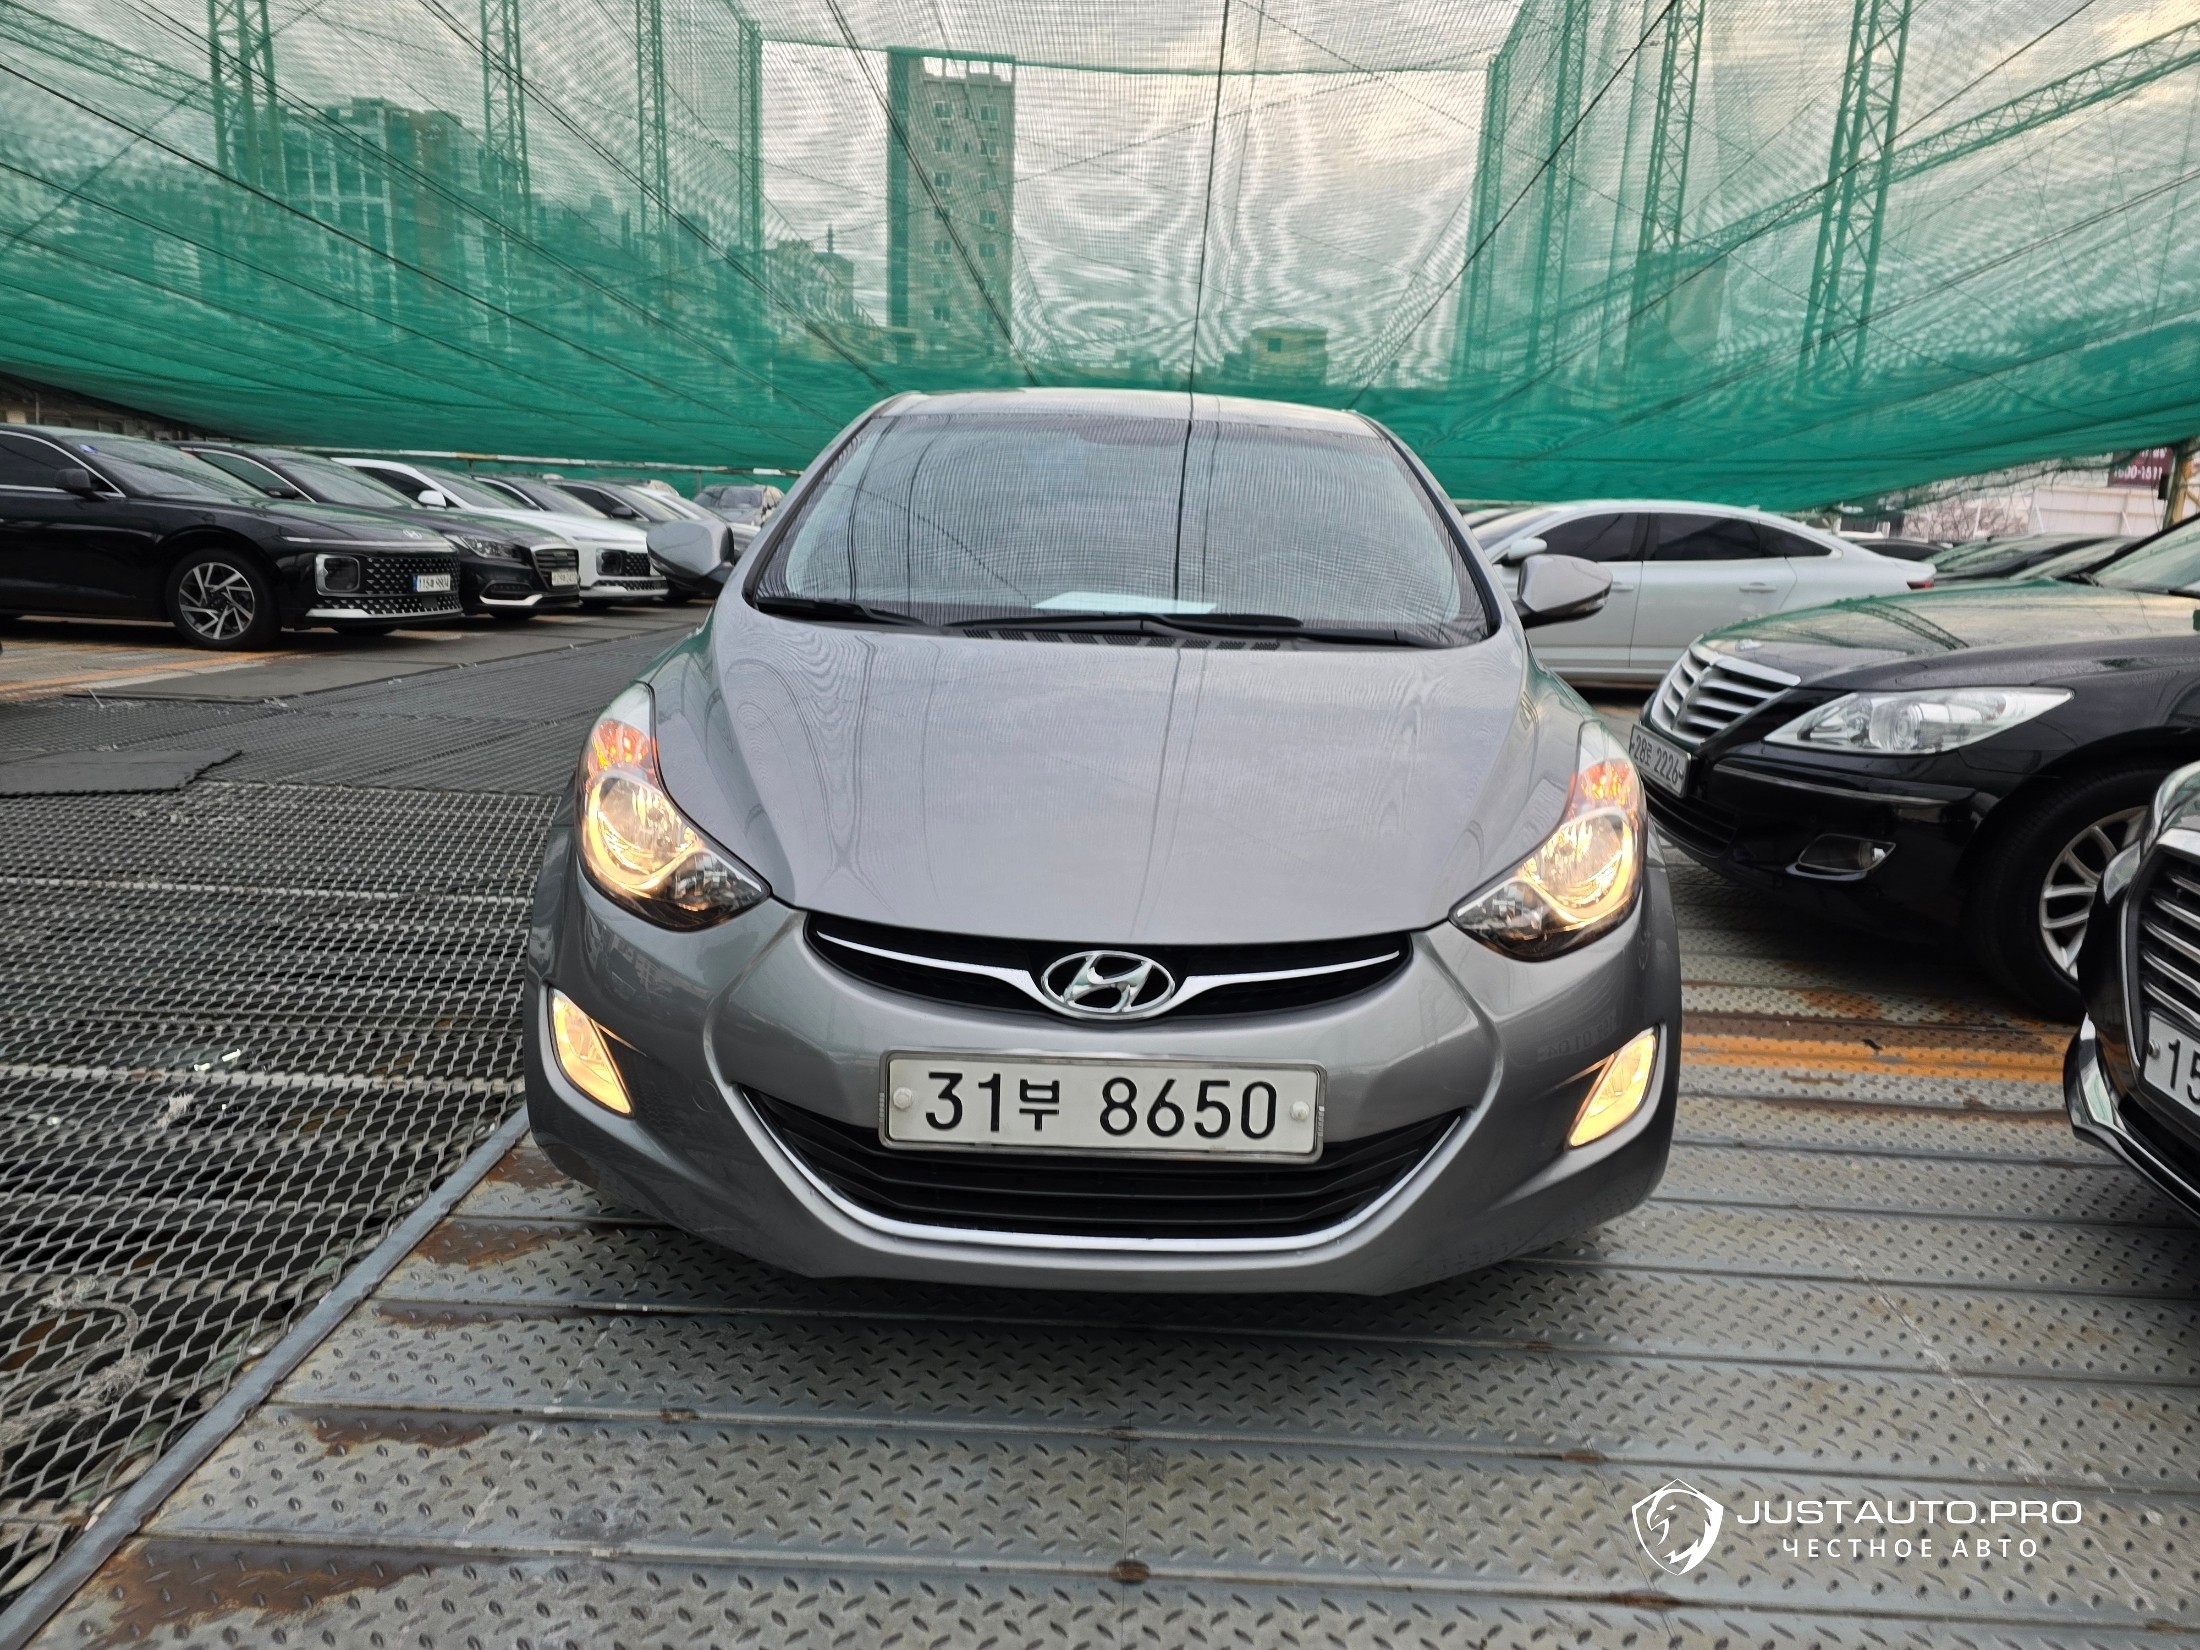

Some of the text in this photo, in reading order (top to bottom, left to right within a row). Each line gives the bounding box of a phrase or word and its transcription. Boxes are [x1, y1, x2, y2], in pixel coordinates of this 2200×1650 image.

[1654, 746, 1679, 785] 2226
[925, 1071, 1278, 1140] 31부 8650
